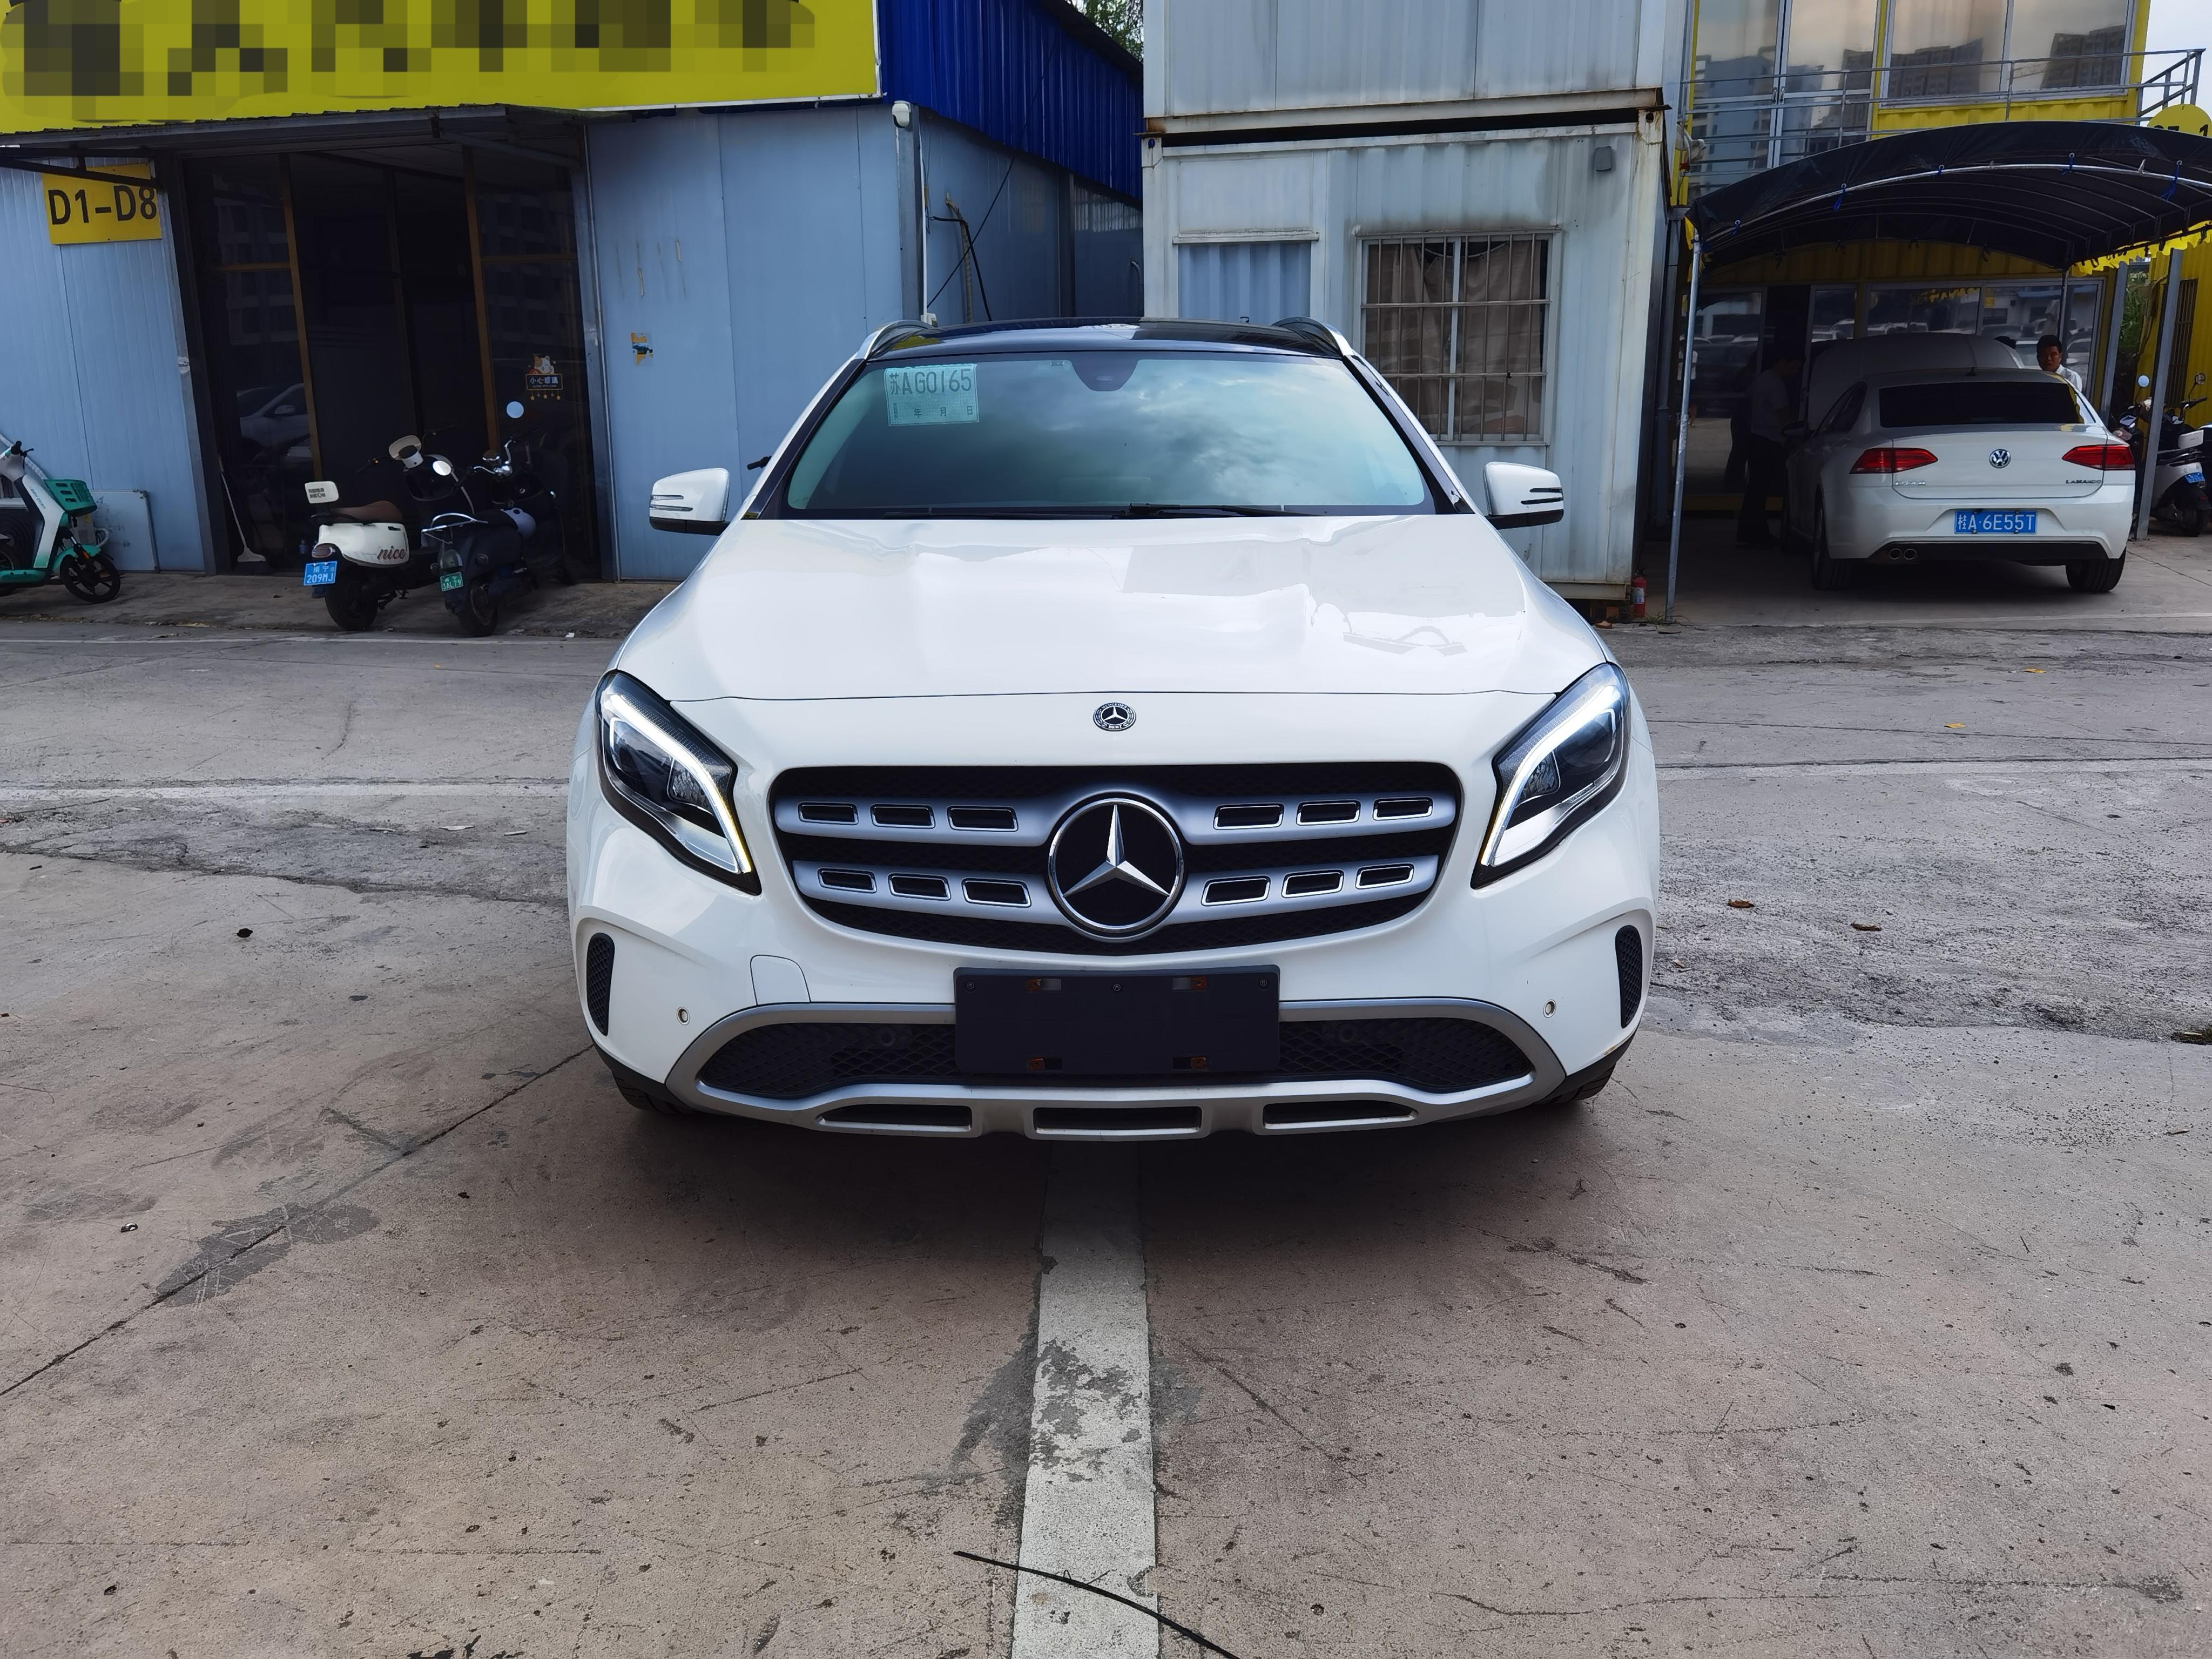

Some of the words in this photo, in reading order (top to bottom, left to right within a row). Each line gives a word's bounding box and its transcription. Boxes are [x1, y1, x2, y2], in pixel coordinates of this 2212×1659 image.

[48, 185, 157, 224] D1-D8
[377, 545, 406, 560] nice
[306, 572, 334, 584] 209MJ
